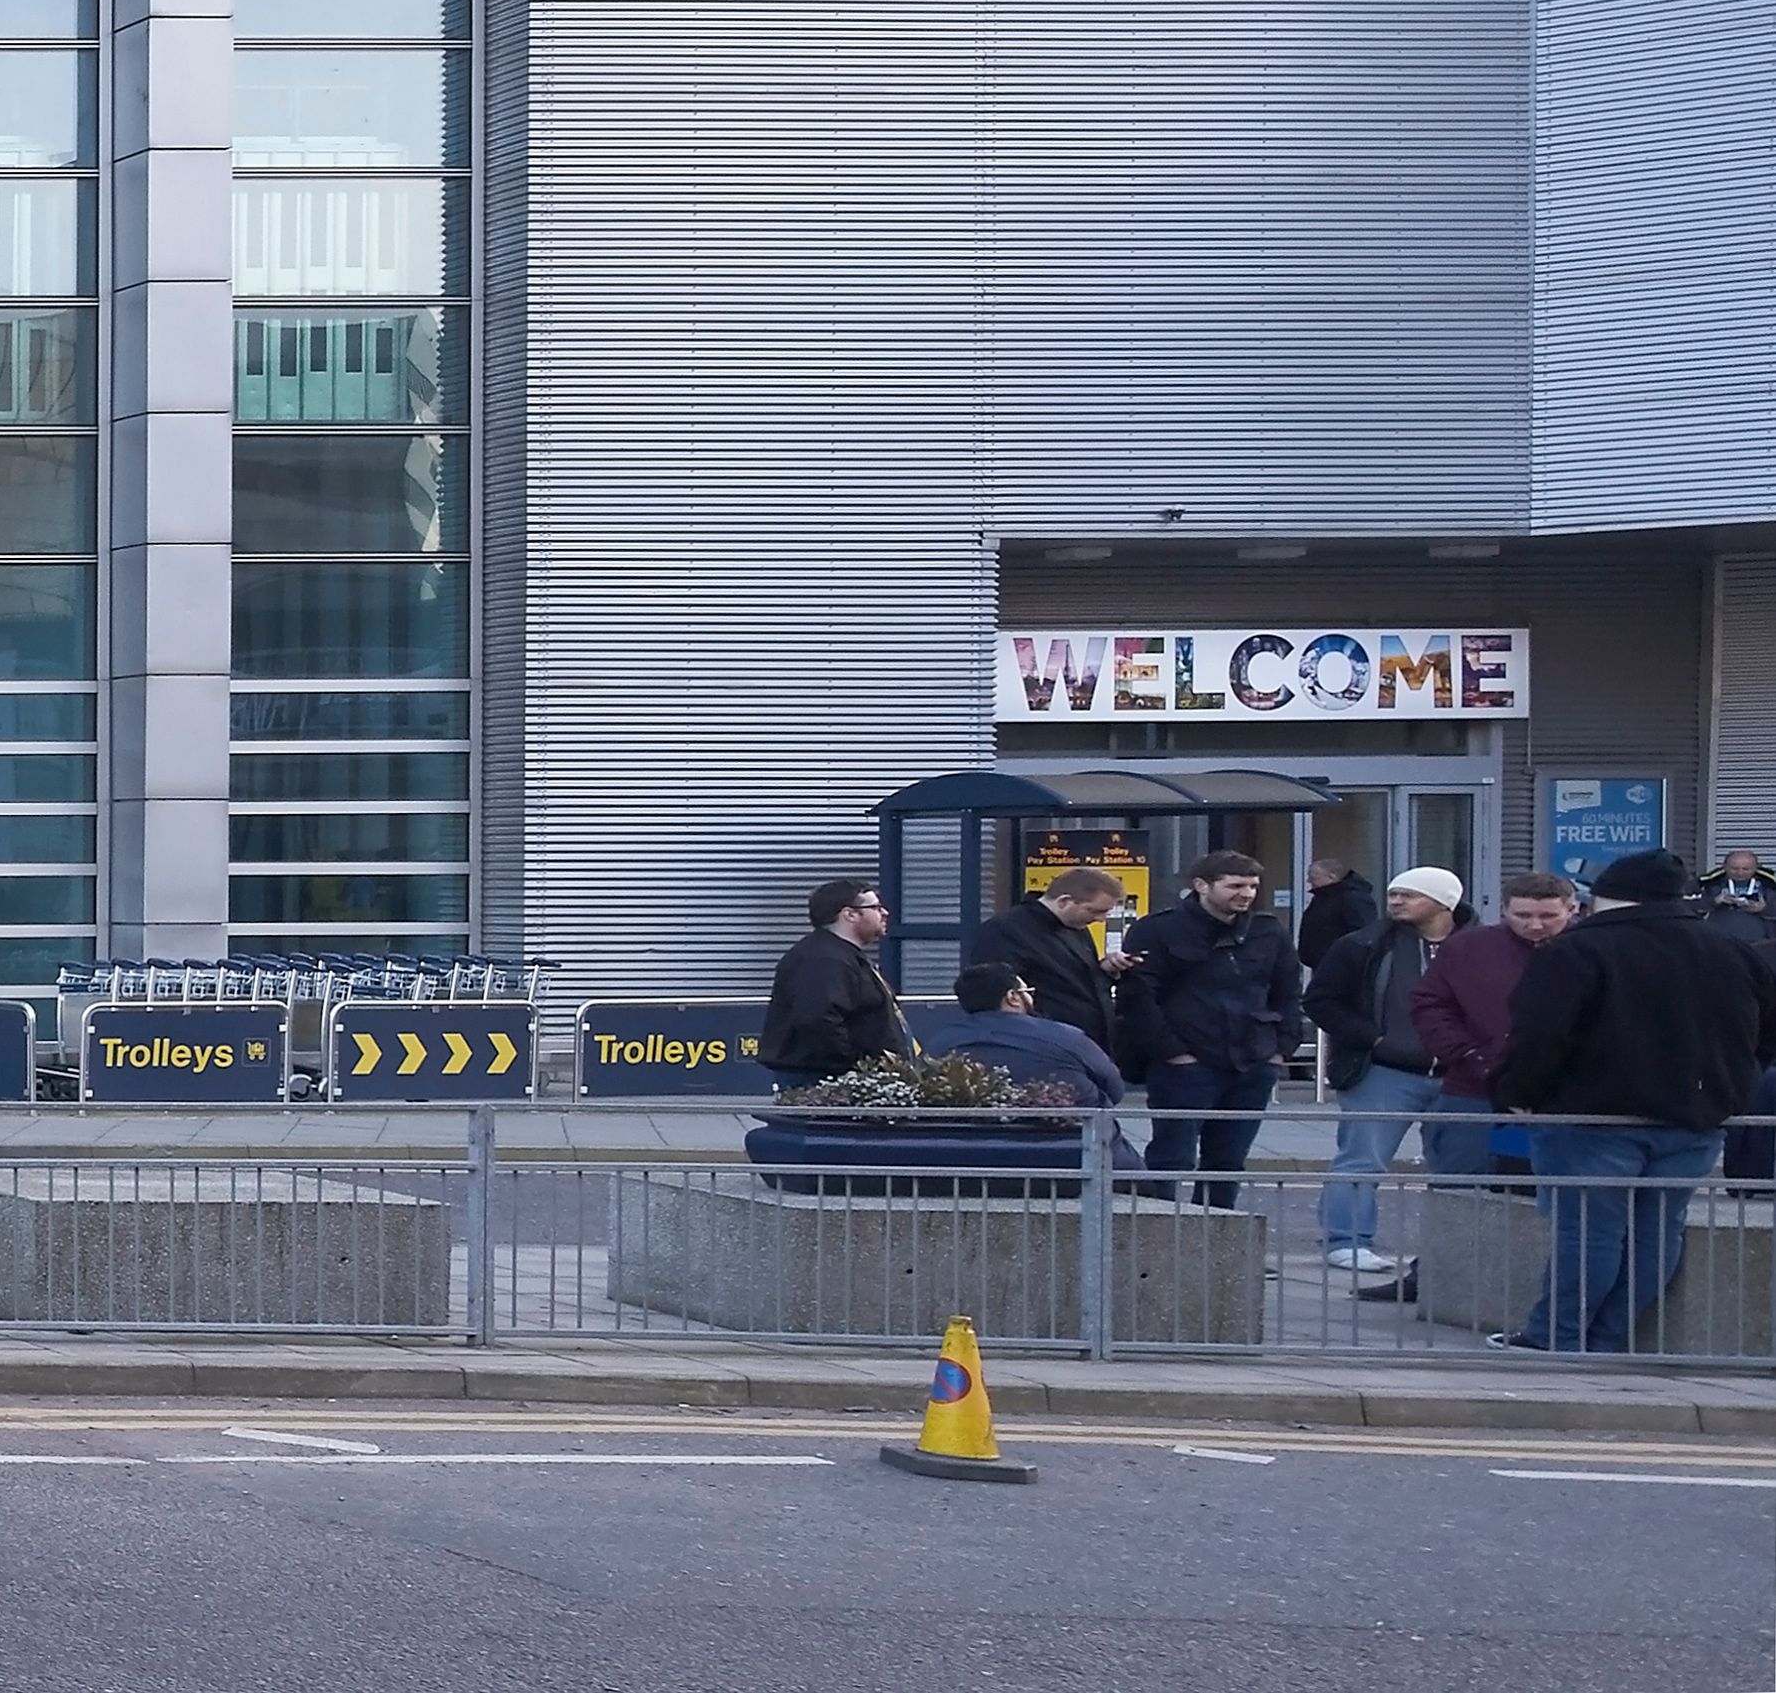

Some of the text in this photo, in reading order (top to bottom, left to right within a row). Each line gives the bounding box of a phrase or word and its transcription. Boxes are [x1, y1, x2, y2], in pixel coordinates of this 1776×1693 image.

[1012, 633, 1515, 711] WELCOME
[1556, 825, 1650, 843] FREE WiFi
[1597, 812, 1651, 824] MINUTES
[99, 1037, 234, 1074] Trolleys
[593, 1034, 727, 1069] Trolleys
